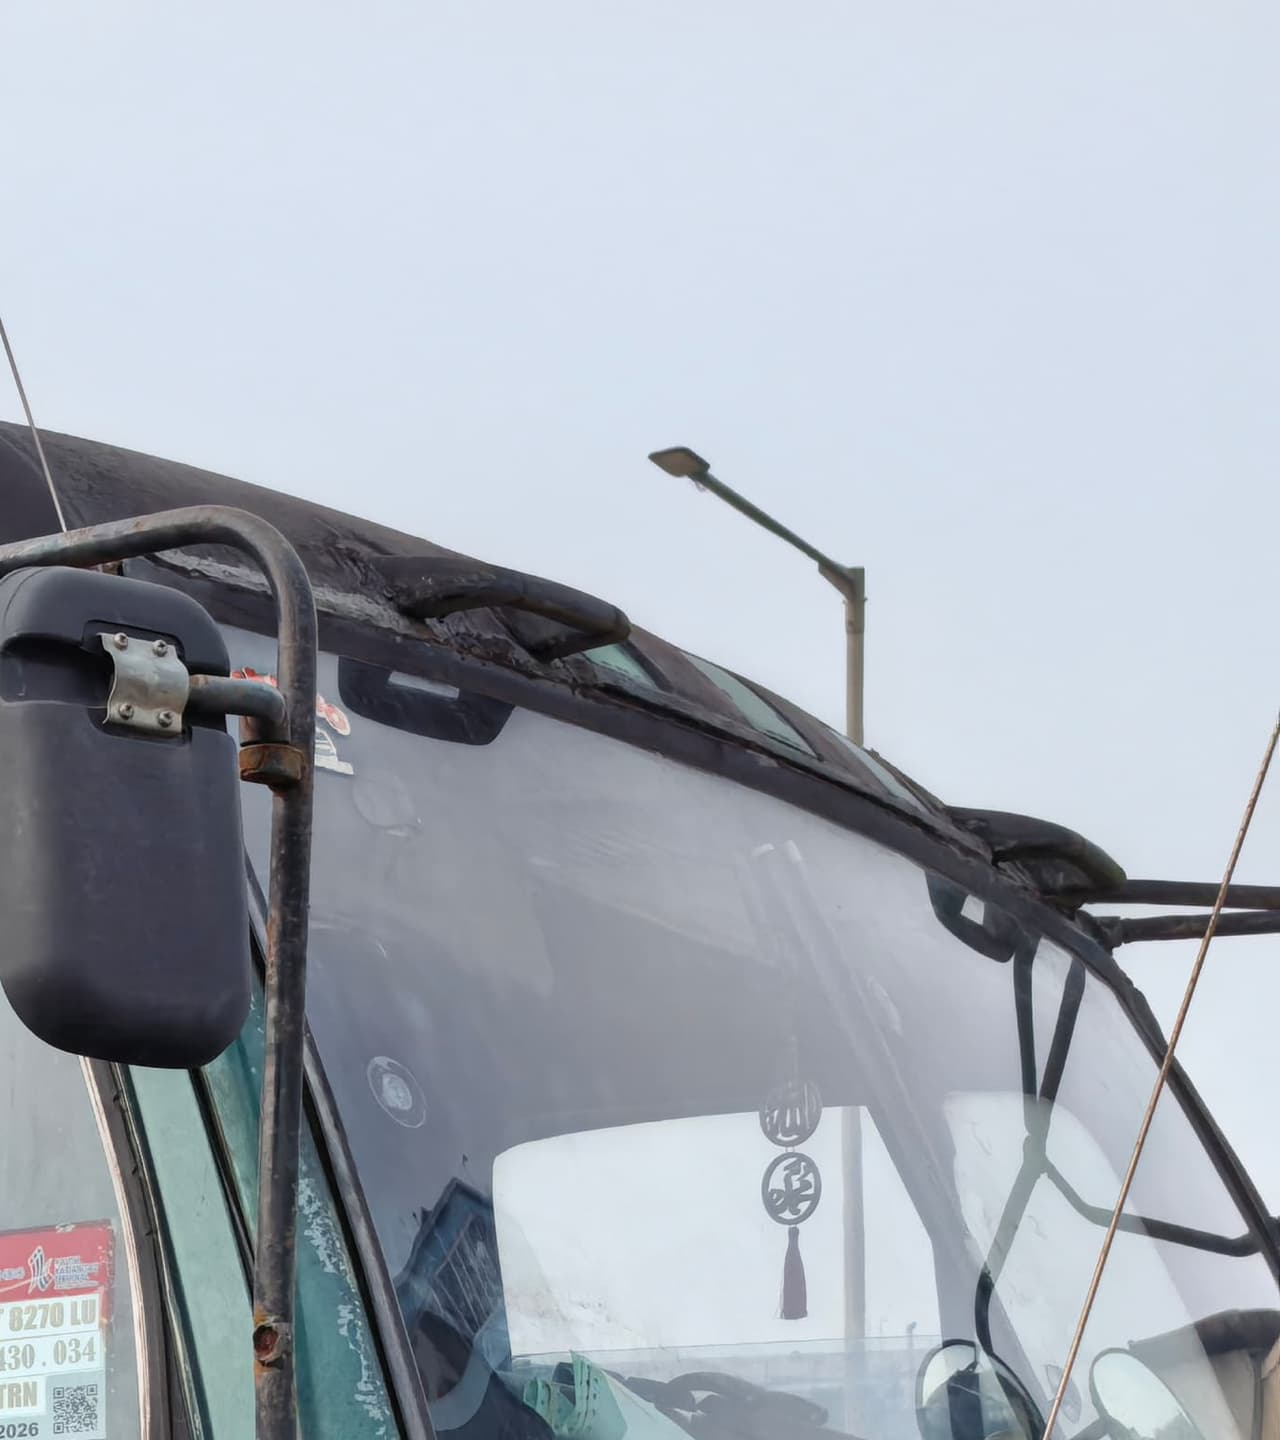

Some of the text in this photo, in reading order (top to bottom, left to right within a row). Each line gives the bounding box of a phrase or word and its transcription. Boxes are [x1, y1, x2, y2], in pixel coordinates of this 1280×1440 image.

[9, 1302, 64, 1332] 8270
[70, 1299, 97, 1326] LU
[53, 1336, 96, 1365] 034
